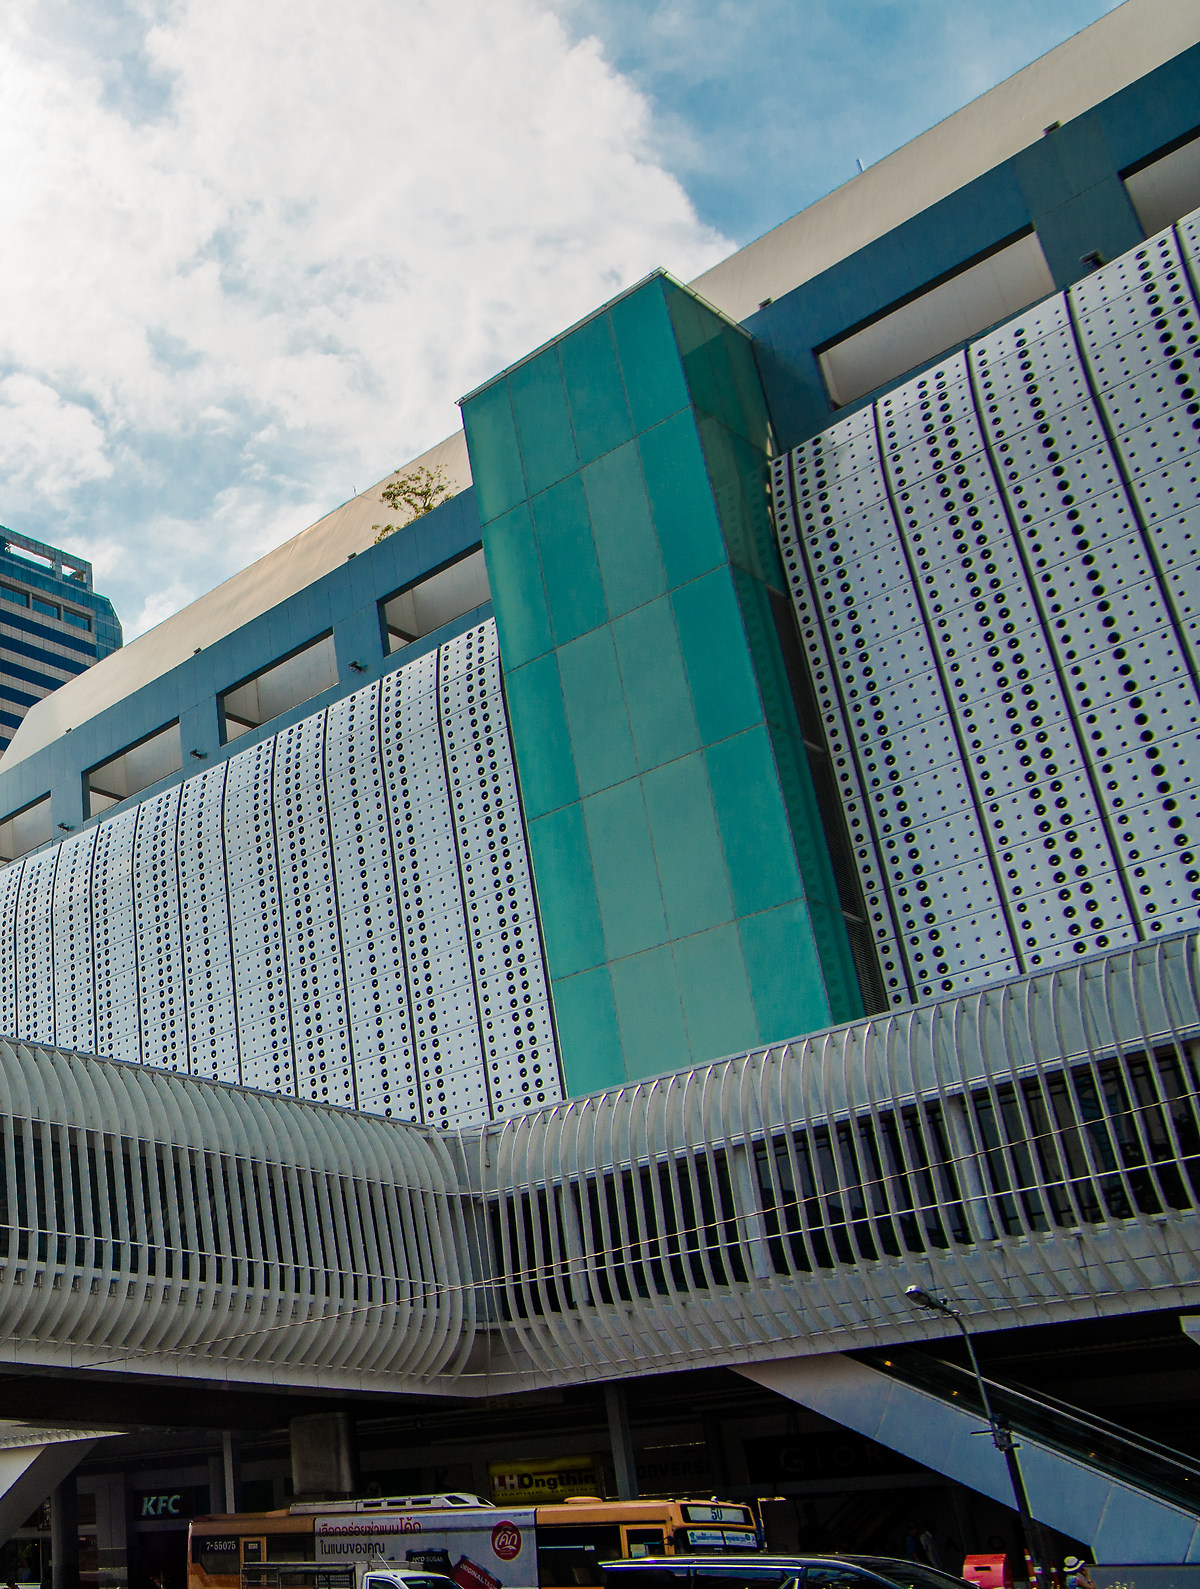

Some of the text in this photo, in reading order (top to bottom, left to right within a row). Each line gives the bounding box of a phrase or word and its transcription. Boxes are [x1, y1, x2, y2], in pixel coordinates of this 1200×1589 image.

[141, 1494, 182, 1516] KFC
[711, 1507, 722, 1520] 50
[205, 1540, 237, 1551] 7-55075
[320, 1540, 385, 1558] ในแบบของคุณ
